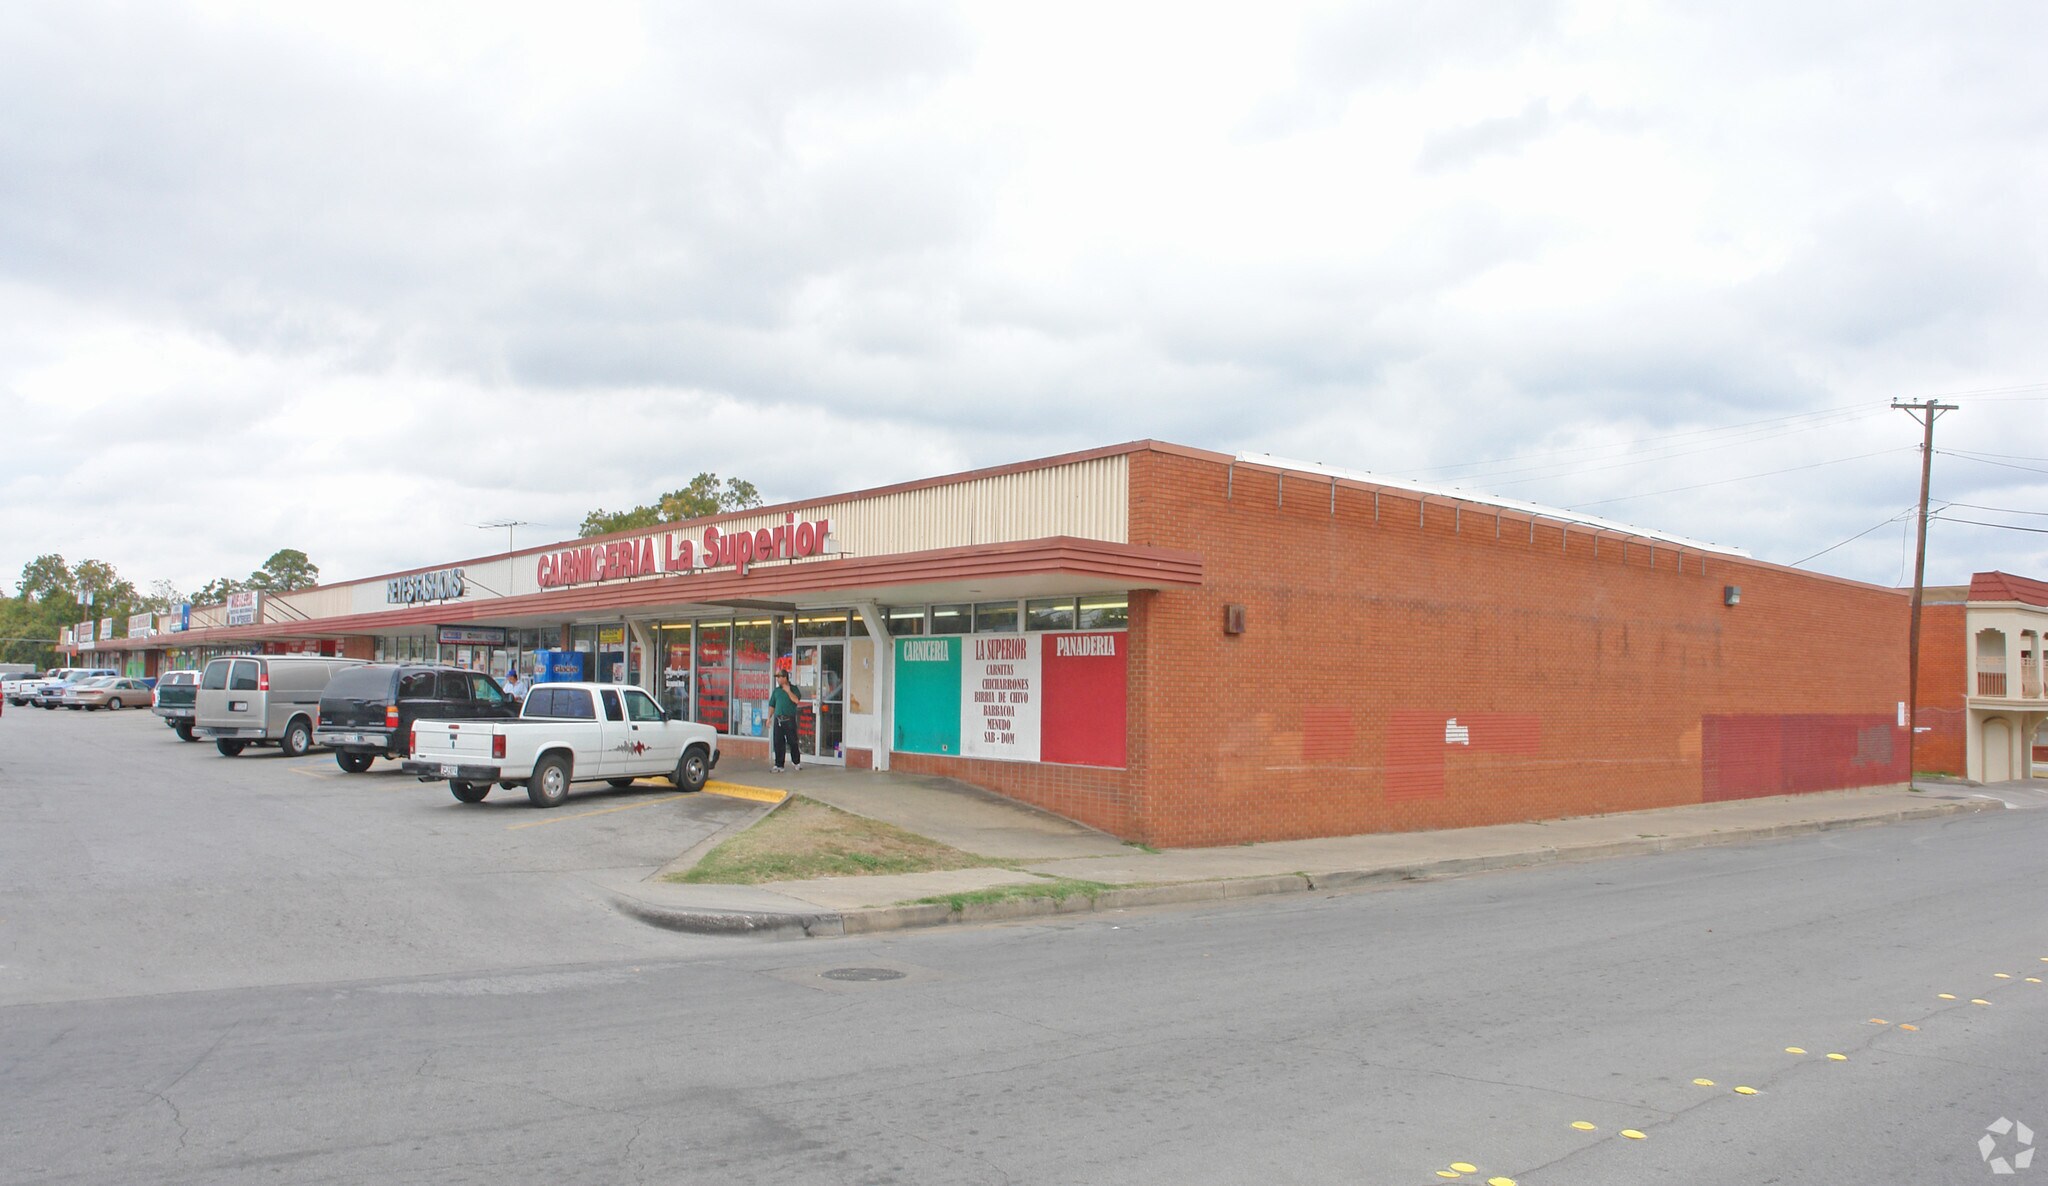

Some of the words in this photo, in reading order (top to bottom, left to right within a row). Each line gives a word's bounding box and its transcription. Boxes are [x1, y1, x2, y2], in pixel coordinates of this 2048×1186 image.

[537, 537, 656, 588] CARNICERIA
[665, 533, 693, 571] La
[703, 512, 829, 575] Superior
[415, 568, 463, 602] FASHIONS
[903, 640, 949, 661] CARNICERIA
[975, 640, 985, 660] LA
[987, 638, 1027, 660] SUPERIOR
[1056, 635, 1116, 656] PANADERIA
[986, 664, 1014, 676] CARNITAS
[982, 678, 1029, 690] CHICHARRONES
[974, 691, 995, 703] BIRRIA
[998, 691, 1006, 703] DE
[1009, 692, 1029, 704] CHIVO
[983, 705, 1015, 717] BARBACOA
[987, 719, 1011, 731] MENUDO
[984, 732, 996, 743] SAB
[1001, 732, 1015, 745] DOM
